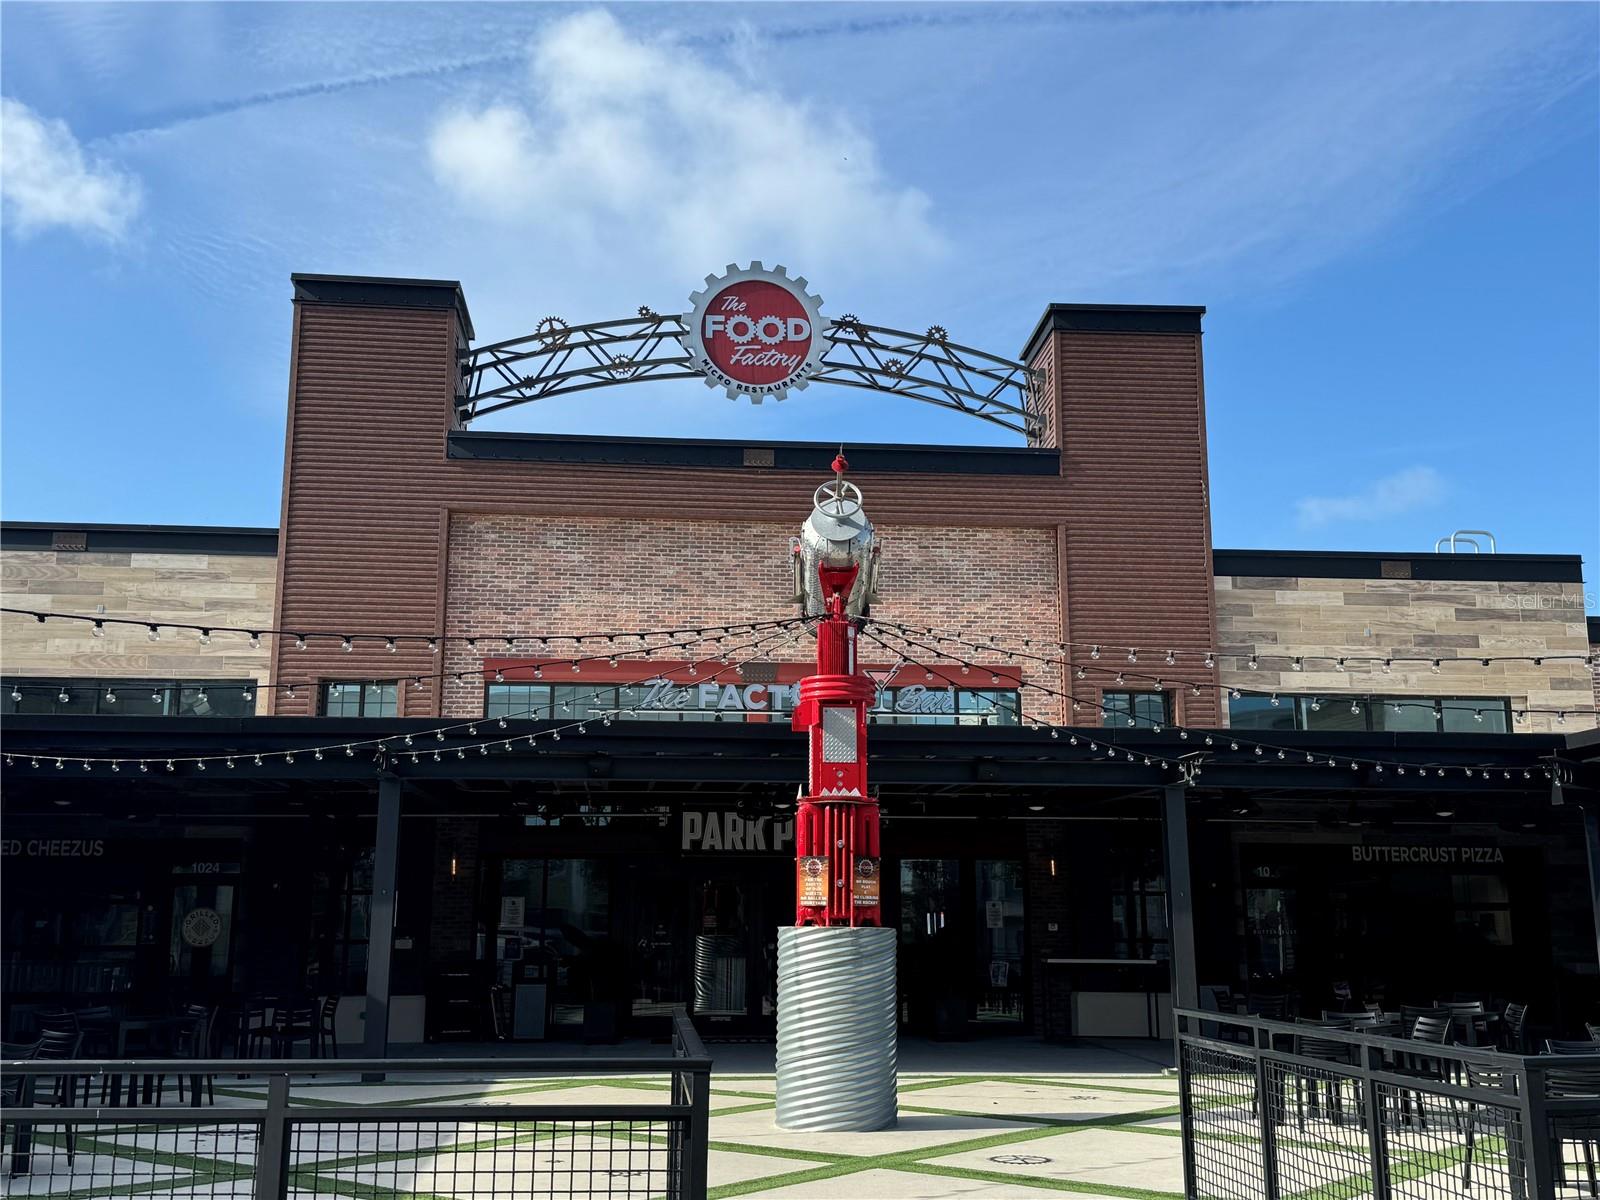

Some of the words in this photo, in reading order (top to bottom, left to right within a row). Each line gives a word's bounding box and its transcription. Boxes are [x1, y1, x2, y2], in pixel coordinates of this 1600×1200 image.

[722, 296, 747, 311] The
[704, 314, 811, 345] FOOD
[730, 346, 802, 374] Factory
[701, 358, 731, 387] MICRO
[736, 361, 813, 393] RESTAURANTS
[641, 678, 692, 710] The
[895, 684, 953, 713] Bar
[682, 811, 767, 850] PARK
[27, 840, 104, 856] CHEEZUS
[1352, 846, 1457, 862] BUTTERCRUST
[1462, 847, 1504, 862] PIZZA
[192, 862, 219, 874] 1024
